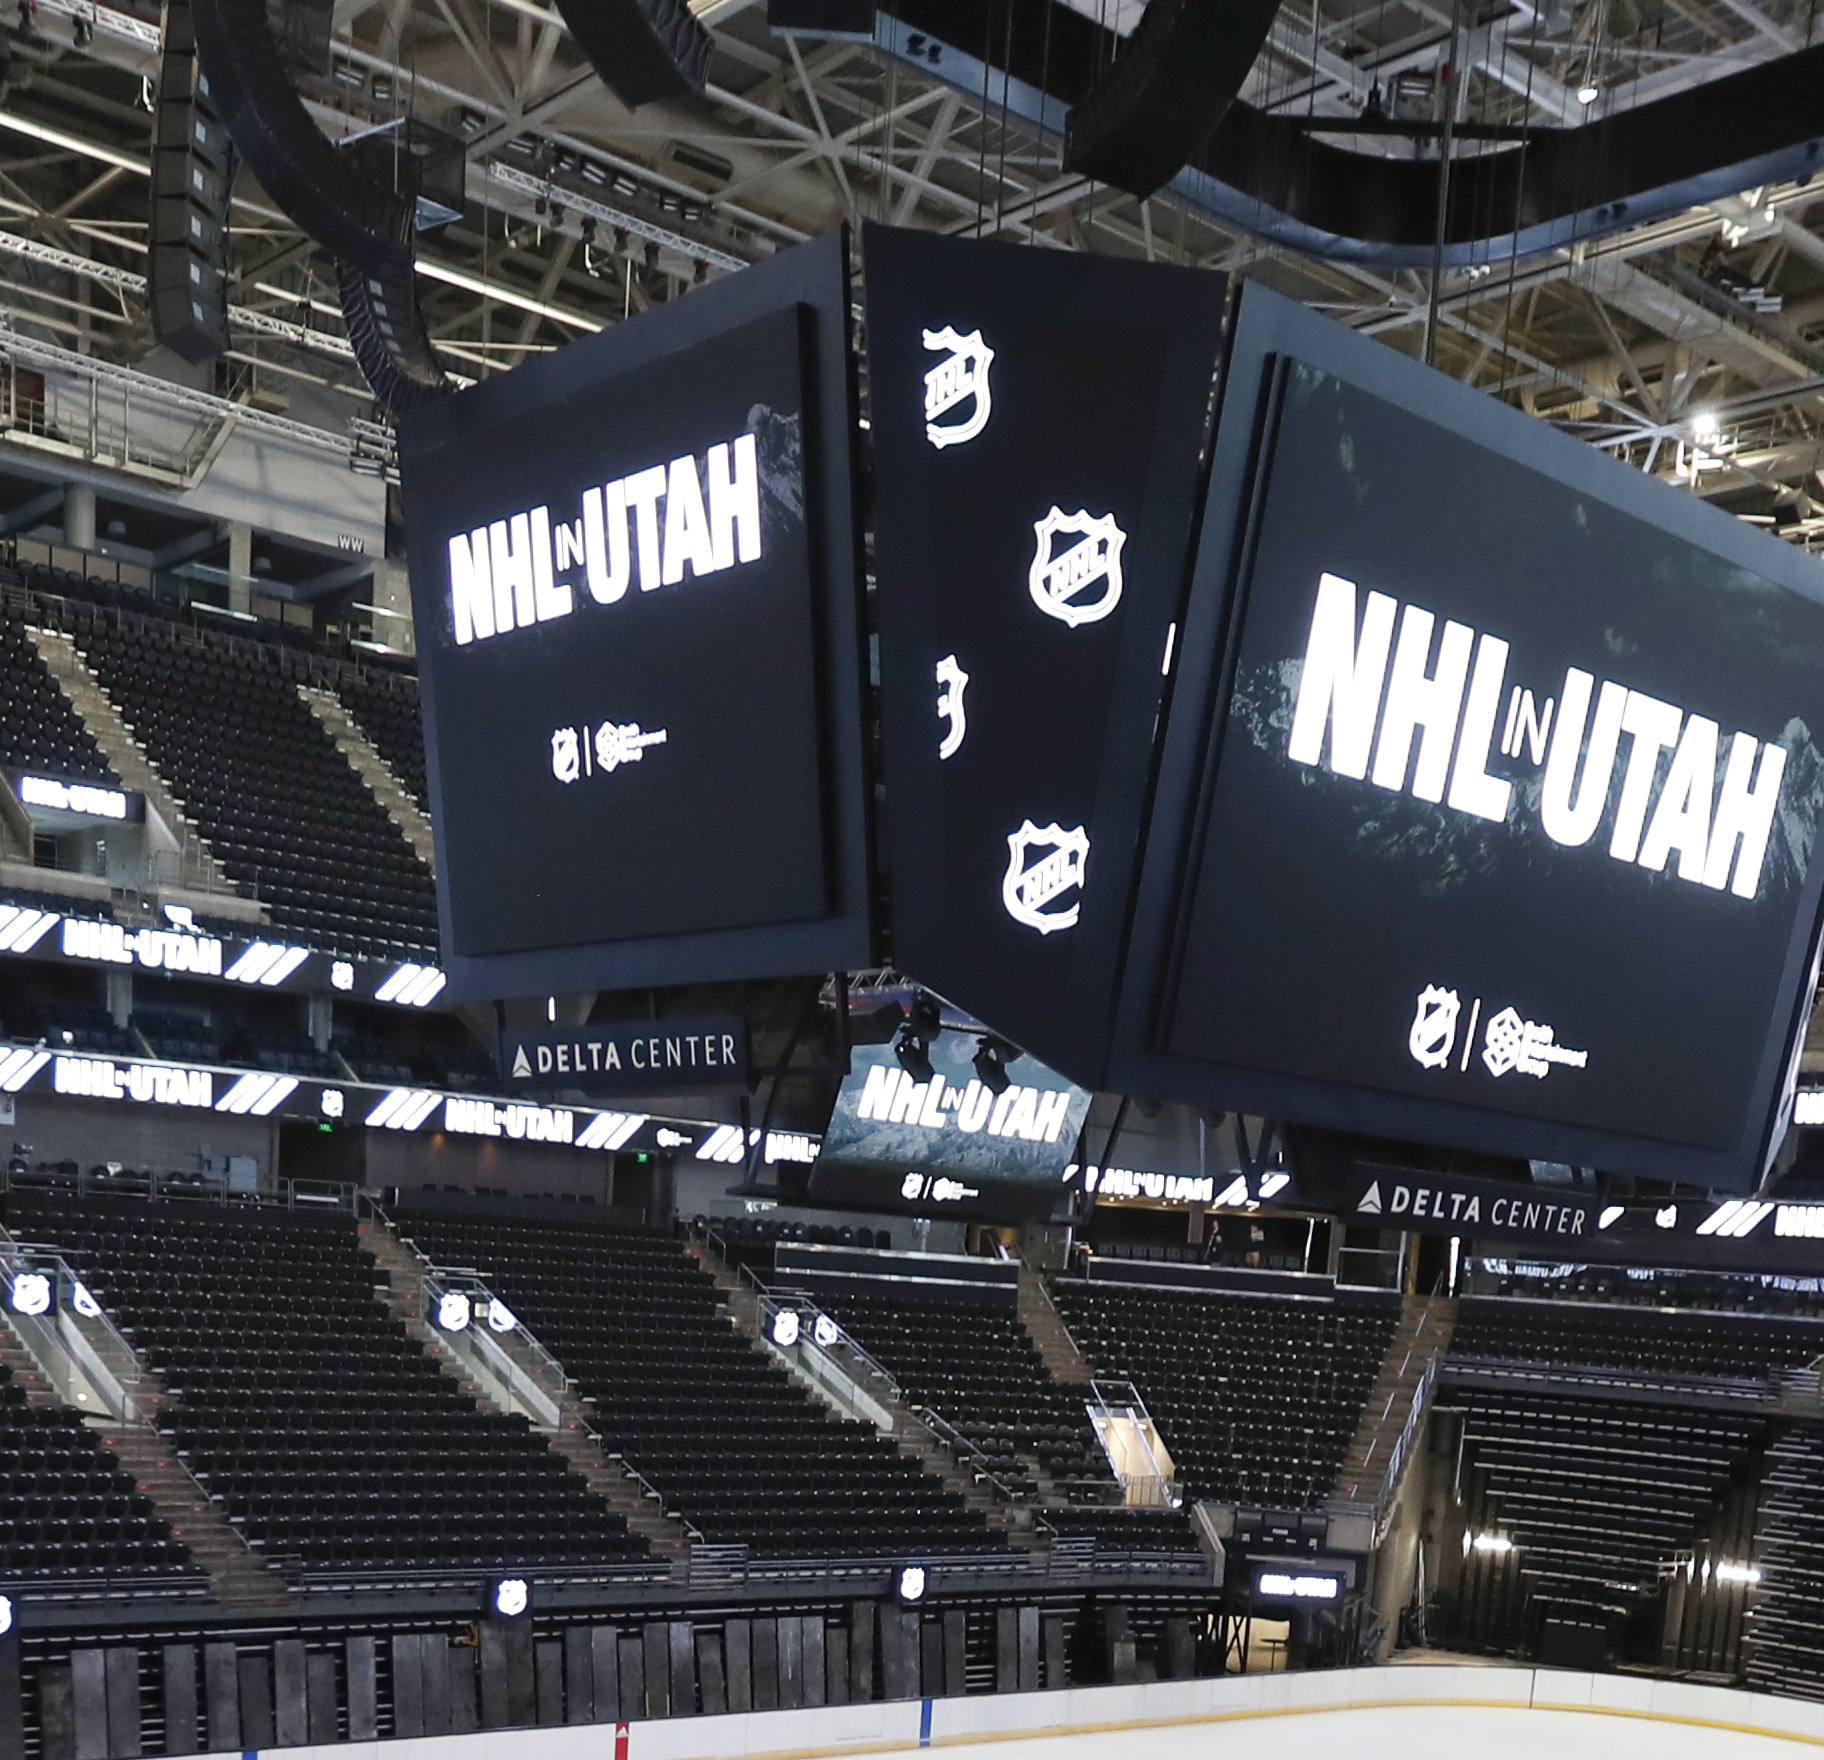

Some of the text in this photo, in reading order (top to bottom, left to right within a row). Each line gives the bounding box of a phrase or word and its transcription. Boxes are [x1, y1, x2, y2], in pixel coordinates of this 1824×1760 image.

[339, 534, 363, 552] WW
[448, 432, 762, 646] NHL IN UTAH
[1287, 571, 1788, 901] NHL IN UTAH
[63, 918, 133, 964] NHL
[537, 1034, 736, 1073] DELTA CENTER
[55, 1056, 124, 1098] NHL
[444, 1098, 501, 1136] NHL
[857, 1064, 947, 1128] NHL
[957, 1079, 1071, 1142] UTAH
[1390, 1185, 1585, 1235] DELTA CENTER
